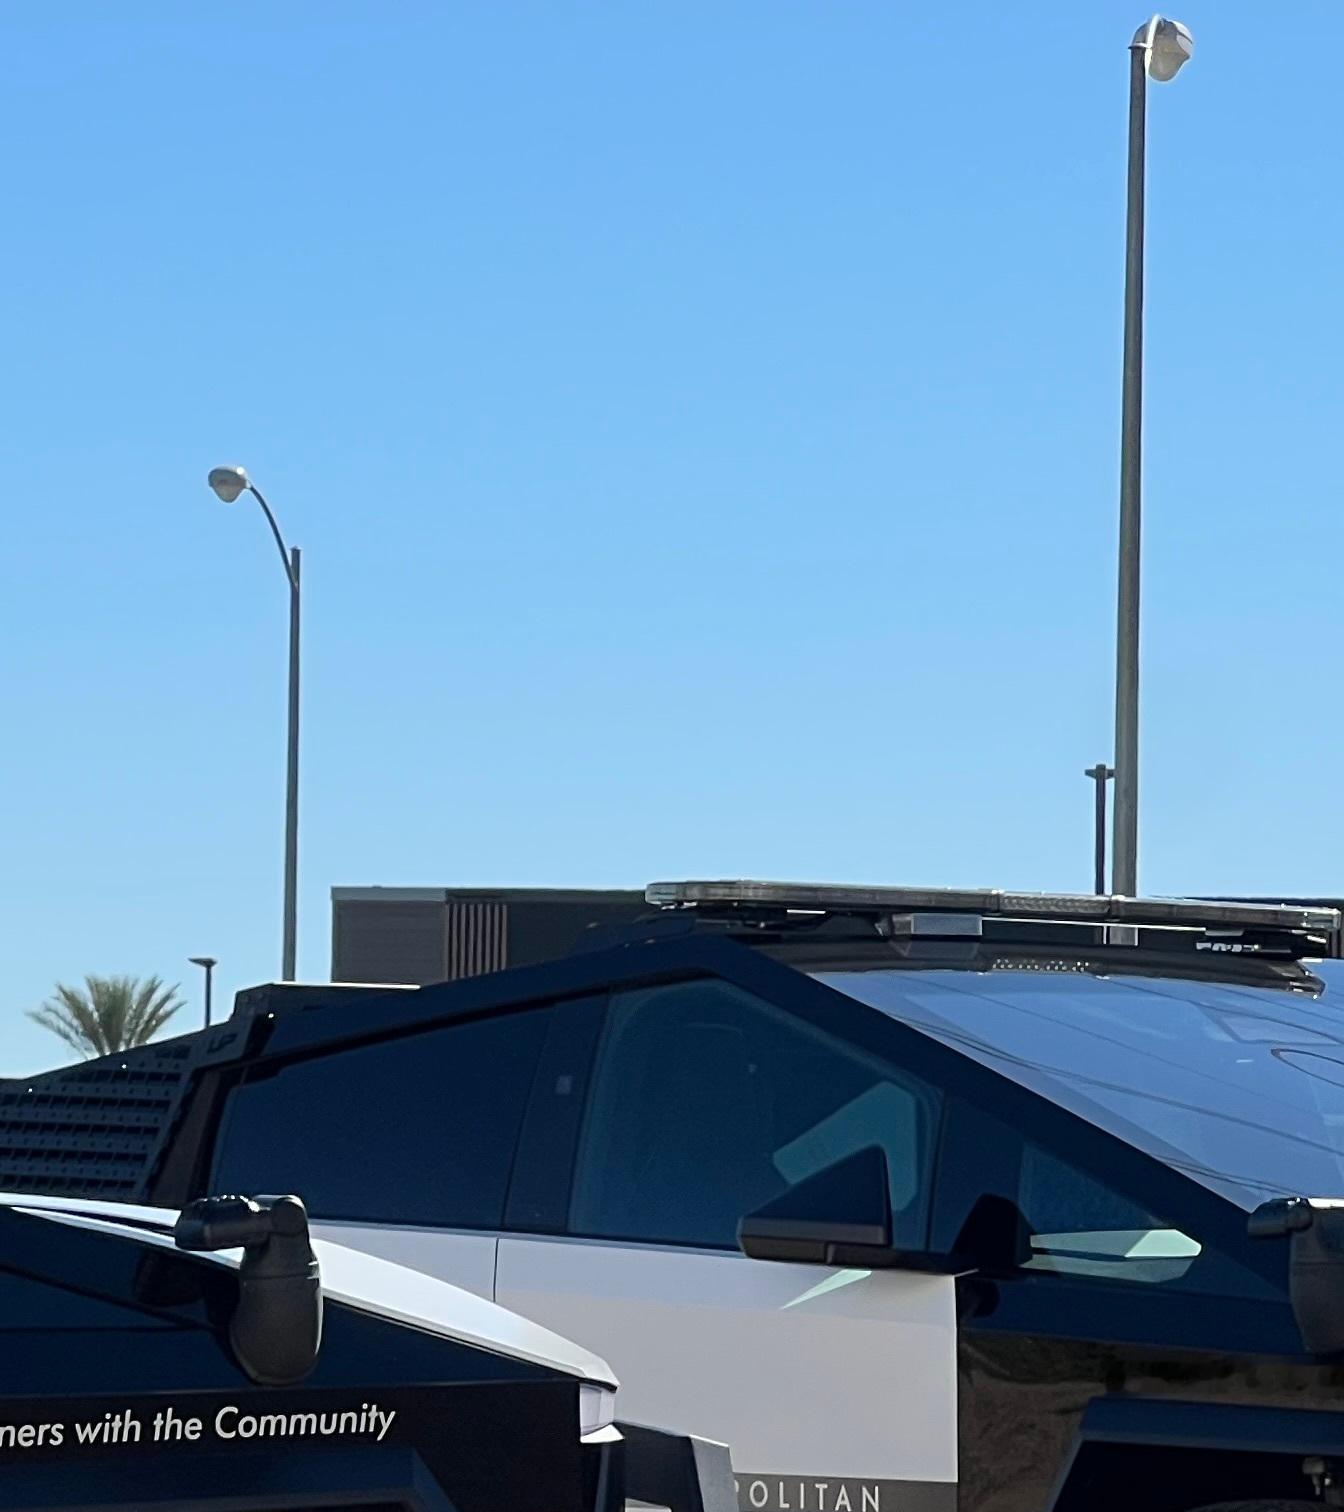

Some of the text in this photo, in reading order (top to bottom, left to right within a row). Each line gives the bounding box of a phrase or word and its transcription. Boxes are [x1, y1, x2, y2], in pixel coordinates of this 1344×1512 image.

[75, 1409, 142, 1444] with
[154, 1407, 203, 1441] the
[215, 1403, 397, 1441] Community
